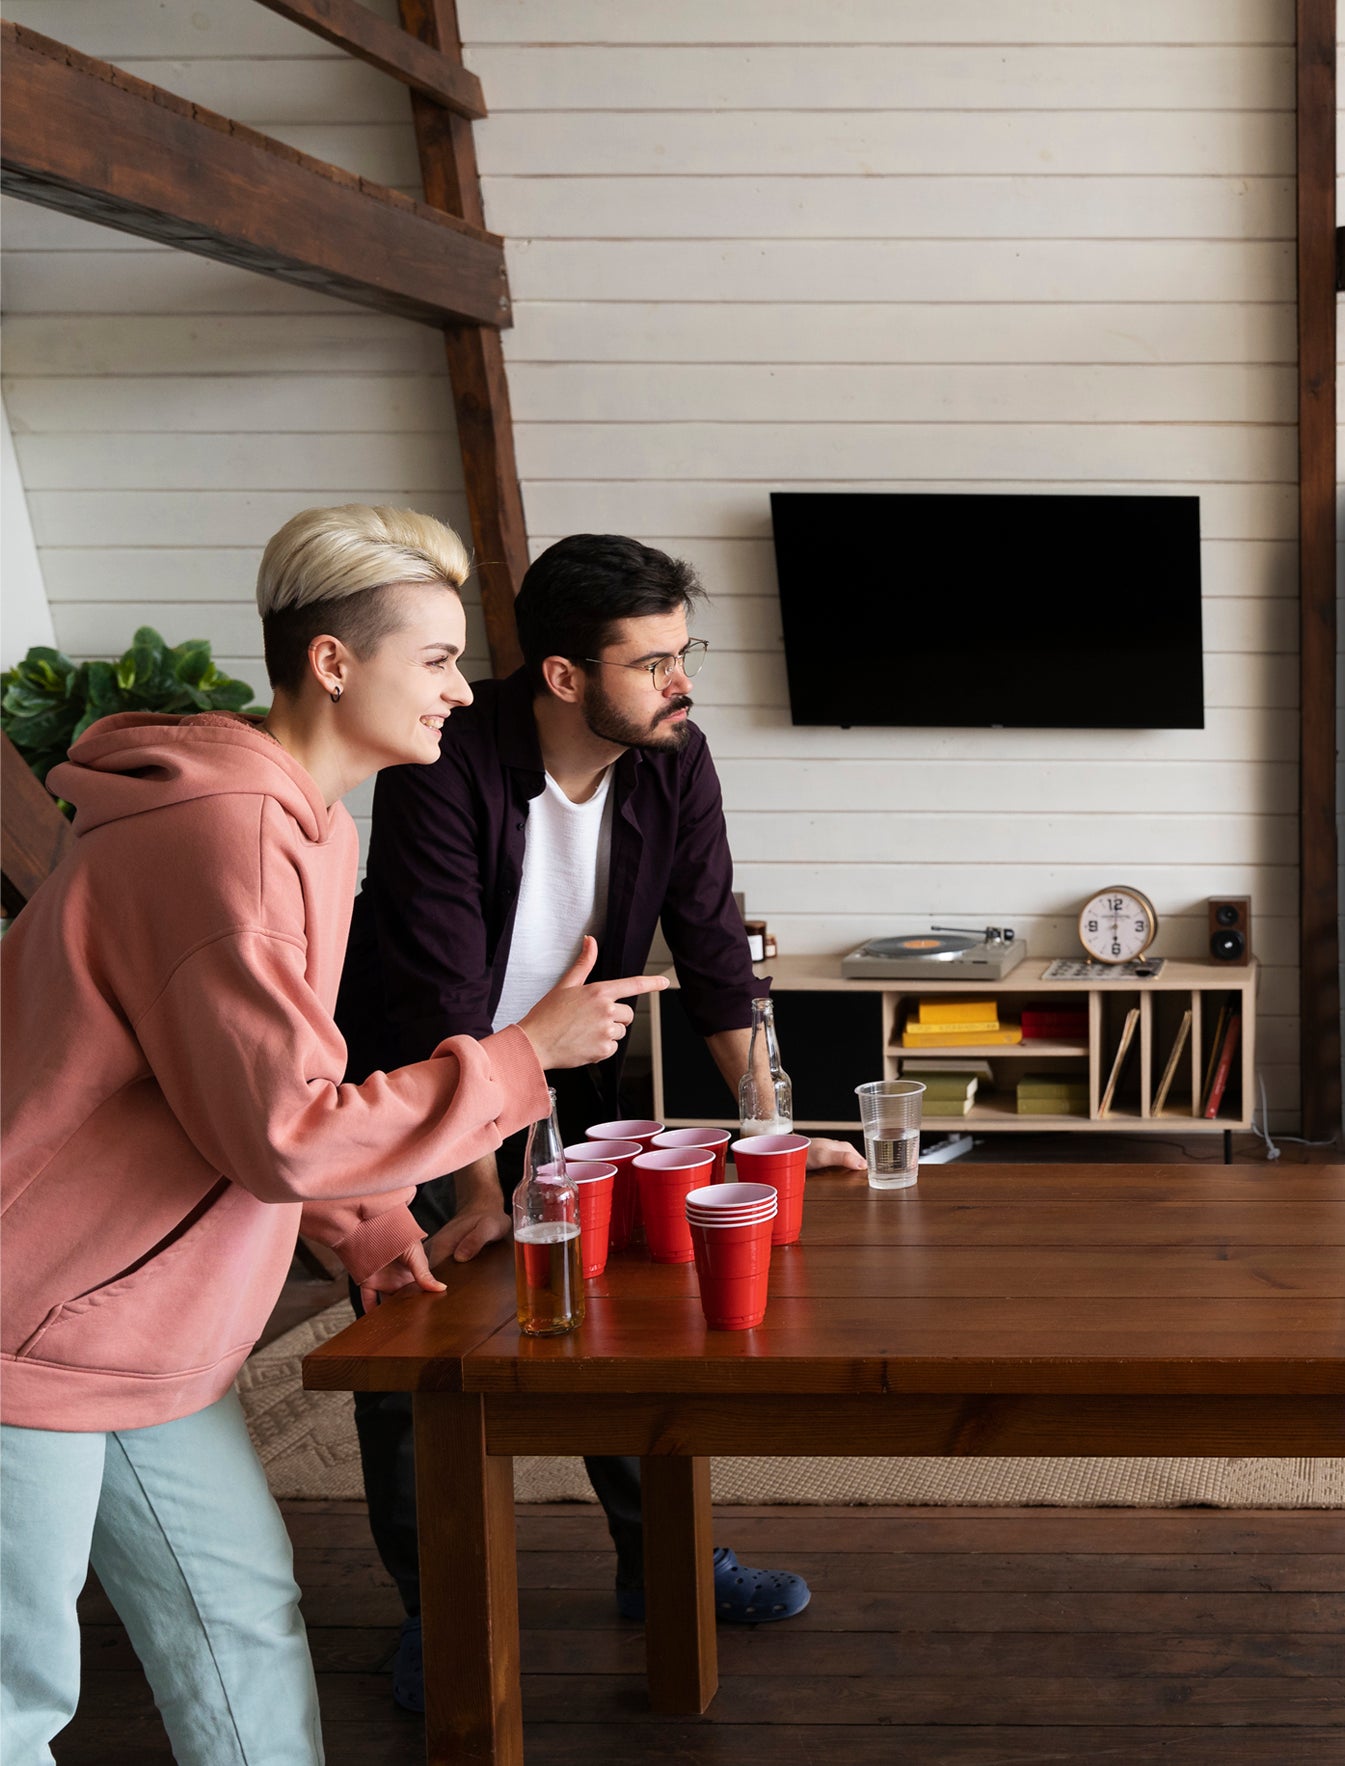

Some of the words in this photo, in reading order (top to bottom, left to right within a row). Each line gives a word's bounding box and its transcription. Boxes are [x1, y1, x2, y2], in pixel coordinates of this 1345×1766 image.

[1107, 899, 1123, 911] 12
[1088, 920, 1098, 932] 9
[1135, 921, 1144, 932] 3
[1112, 943, 1121, 955] 6
